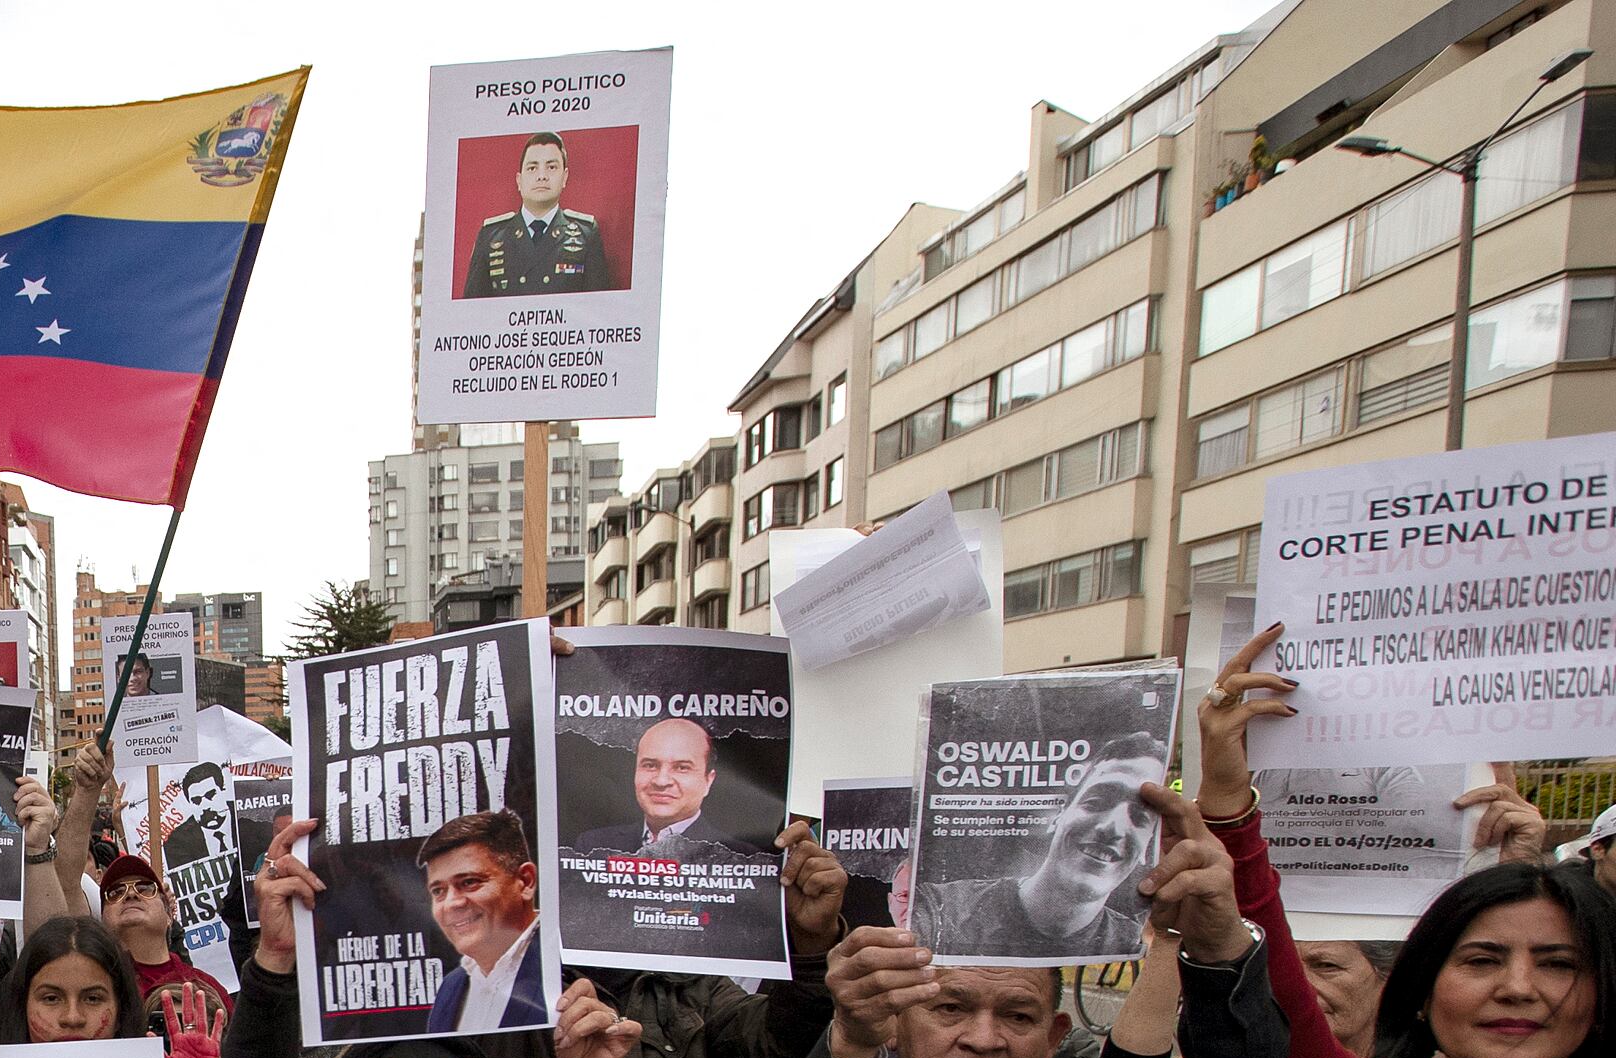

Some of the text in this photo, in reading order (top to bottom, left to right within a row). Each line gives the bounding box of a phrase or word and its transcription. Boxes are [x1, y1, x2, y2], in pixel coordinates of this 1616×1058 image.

[475, 73, 626, 99] PRESO POLITICO
[507, 96, 590, 116] AÑO 2020
[508, 308, 567, 327] CAPITAN.
[434, 327, 641, 352] ANTONIO JOSÉ SEQUEA TORRES
[469, 348, 603, 372] OPERACIÓN GEDEÓN
[452, 372, 609, 394] RECLUIDO EN EL RODEO
[1370, 475, 1608, 521] ESTATUTO DE
[1280, 518, 1515, 560] CORTE PENAL
[1316, 576, 1531, 624] LE PEDIMOS A LA SALA DE
[151, 630, 189, 640] CHIRINOS
[1275, 616, 1610, 672] SOLICITE AL FISCAL KARIM KHAN EN QUE
[324, 640, 510, 756] FUERZA
[1433, 671, 1516, 706] LA CAUSA
[560, 689, 789, 719] ROLAND CARREÑO
[125, 735, 179, 747] OPERACIÓN
[134, 746, 172, 757] GEDEÓN
[938, 740, 1090, 763] OSWALDO
[936, 764, 1087, 788] CASTILLO
[325, 737, 511, 845] FREDDY
[935, 797, 1065, 807] Siempre ha sido inocente
[1287, 794, 1378, 805] Aldo Rosso
[236, 794, 280, 811] RAFAEL
[1363, 808, 1408, 819] Popular
[934, 814, 1049, 827] Se cumplen años
[826, 828, 910, 850] PERKIN
[933, 827, 1029, 837] de su secuestro
[1268, 835, 1436, 850] NIDO EL 04/07/2024
[560, 858, 779, 878] TIENE 102 DÍAS SIN RECIBIR
[582, 872, 756, 890] VISITA DE SU FAMILIA
[607, 888, 735, 904] #VzlaExigeLibertad
[634, 911, 699, 926] Unitaria
[186, 921, 227, 950] CPI
[337, 931, 425, 962] HÉROE DE LA
[323, 958, 444, 1012] LIBERTAD
